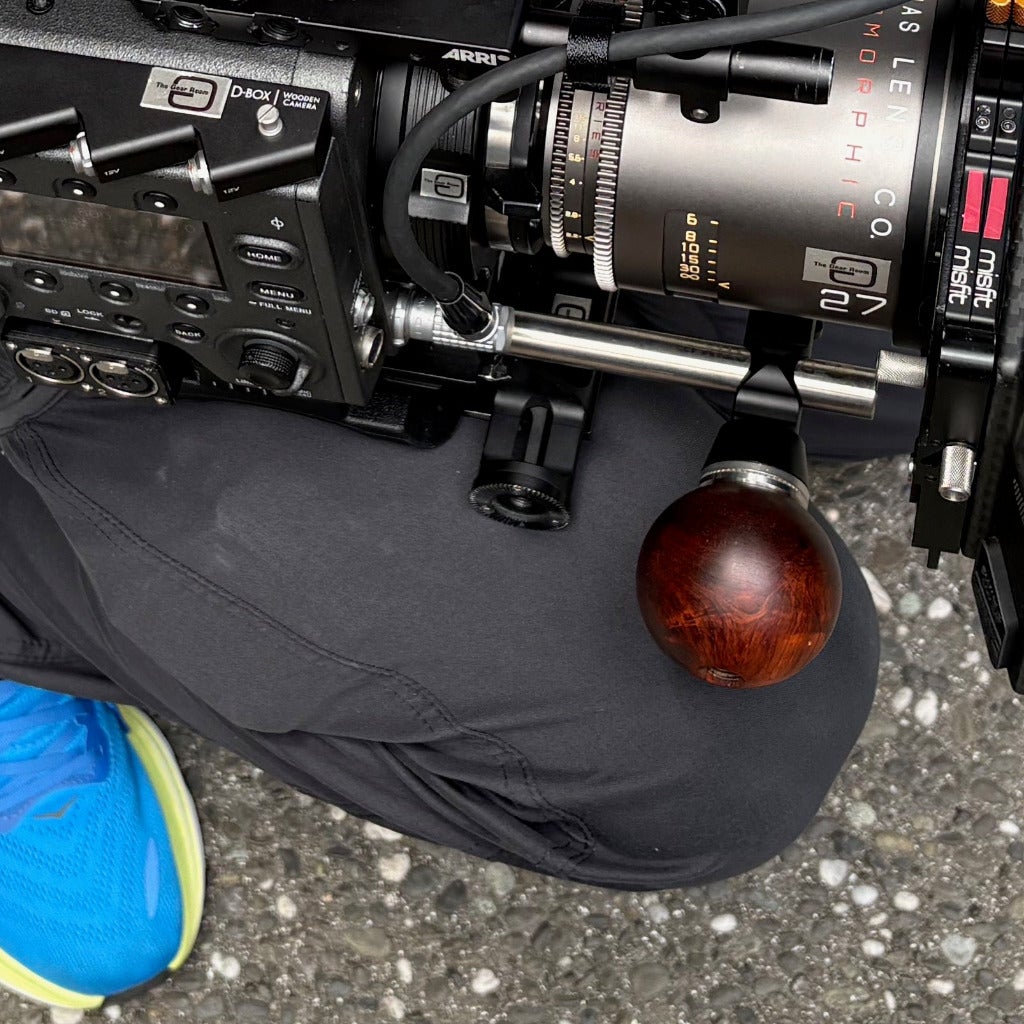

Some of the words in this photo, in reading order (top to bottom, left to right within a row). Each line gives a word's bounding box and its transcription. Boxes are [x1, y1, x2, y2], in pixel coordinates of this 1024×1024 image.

[442, 48, 497, 66] ARRI
[155, 81, 170, 90] The
[170, 84, 189, 93] Gear
[189, 86, 209, 96] Room
[231, 85, 272, 102] D-BOX
[283, 91, 321, 104] WOODEN
[882, 57, 915, 151] LEN
[283, 99, 317, 111] CAMERA
[837, 11, 883, 219] MORPHIC
[686, 213, 698, 226] 6
[870, 188, 896, 239] CO.
[685, 230, 697, 242] 8
[681, 242, 700, 254] 10
[246, 251, 282, 262] HOME
[681, 253, 699, 264] 15
[680, 263, 700, 274] 30
[948, 245, 974, 305] misfit
[973, 249, 1000, 309] misfit
[259, 288, 295, 299] MENU
[258, 301, 283, 311] FULL
[285, 305, 312, 315] MENU
[820, 288, 887, 316] 27
[76, 308, 105, 317] LOCK
[175, 329, 202, 338] BACK
